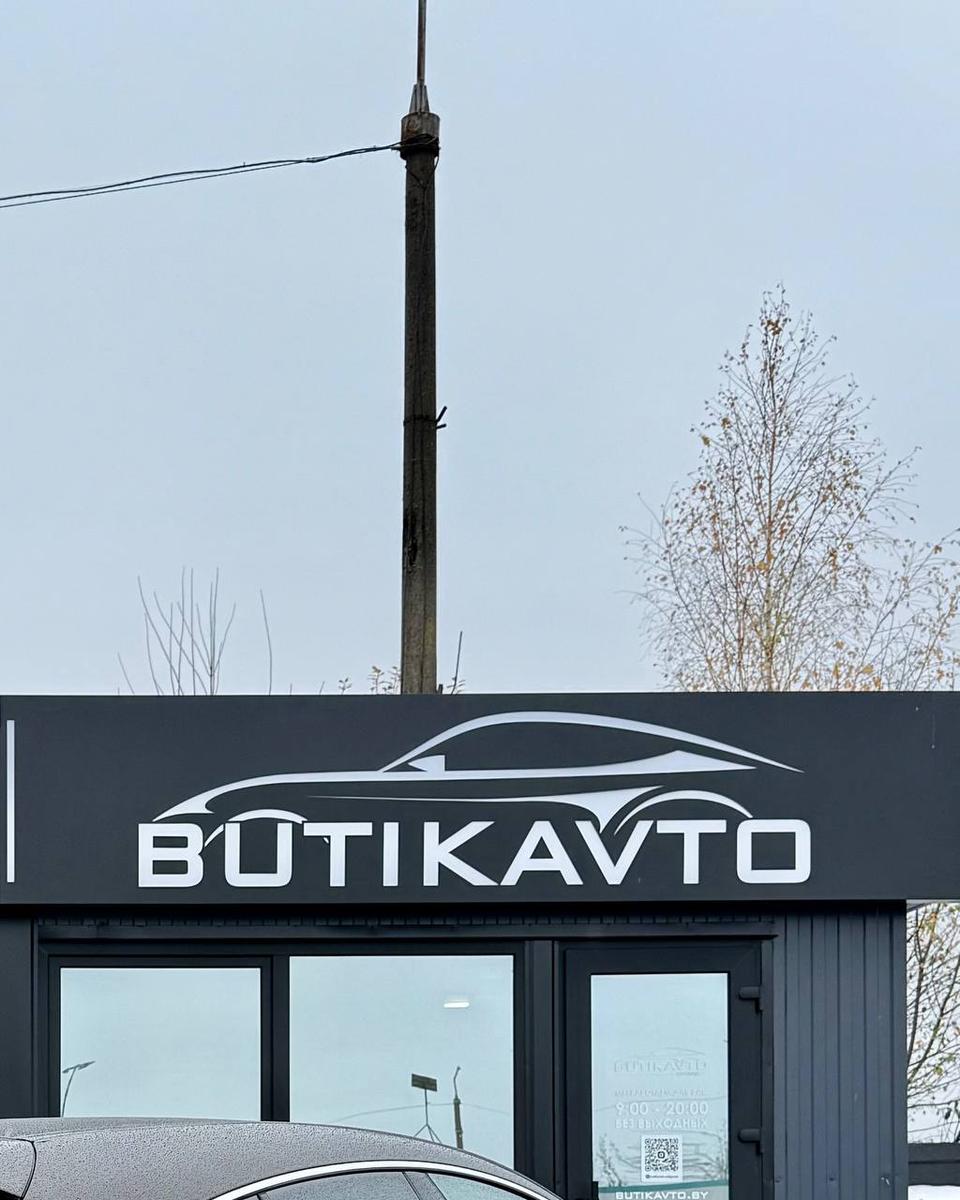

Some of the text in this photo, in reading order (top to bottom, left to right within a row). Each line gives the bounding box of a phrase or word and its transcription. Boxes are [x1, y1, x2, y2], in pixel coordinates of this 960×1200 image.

[138, 819, 812, 887] BUTIKAVTO
[616, 1102, 648, 1116] 9:00
[666, 1102, 709, 1116] 20:00
[616, 1191, 709, 1200] BUTIKAVTO.BY
